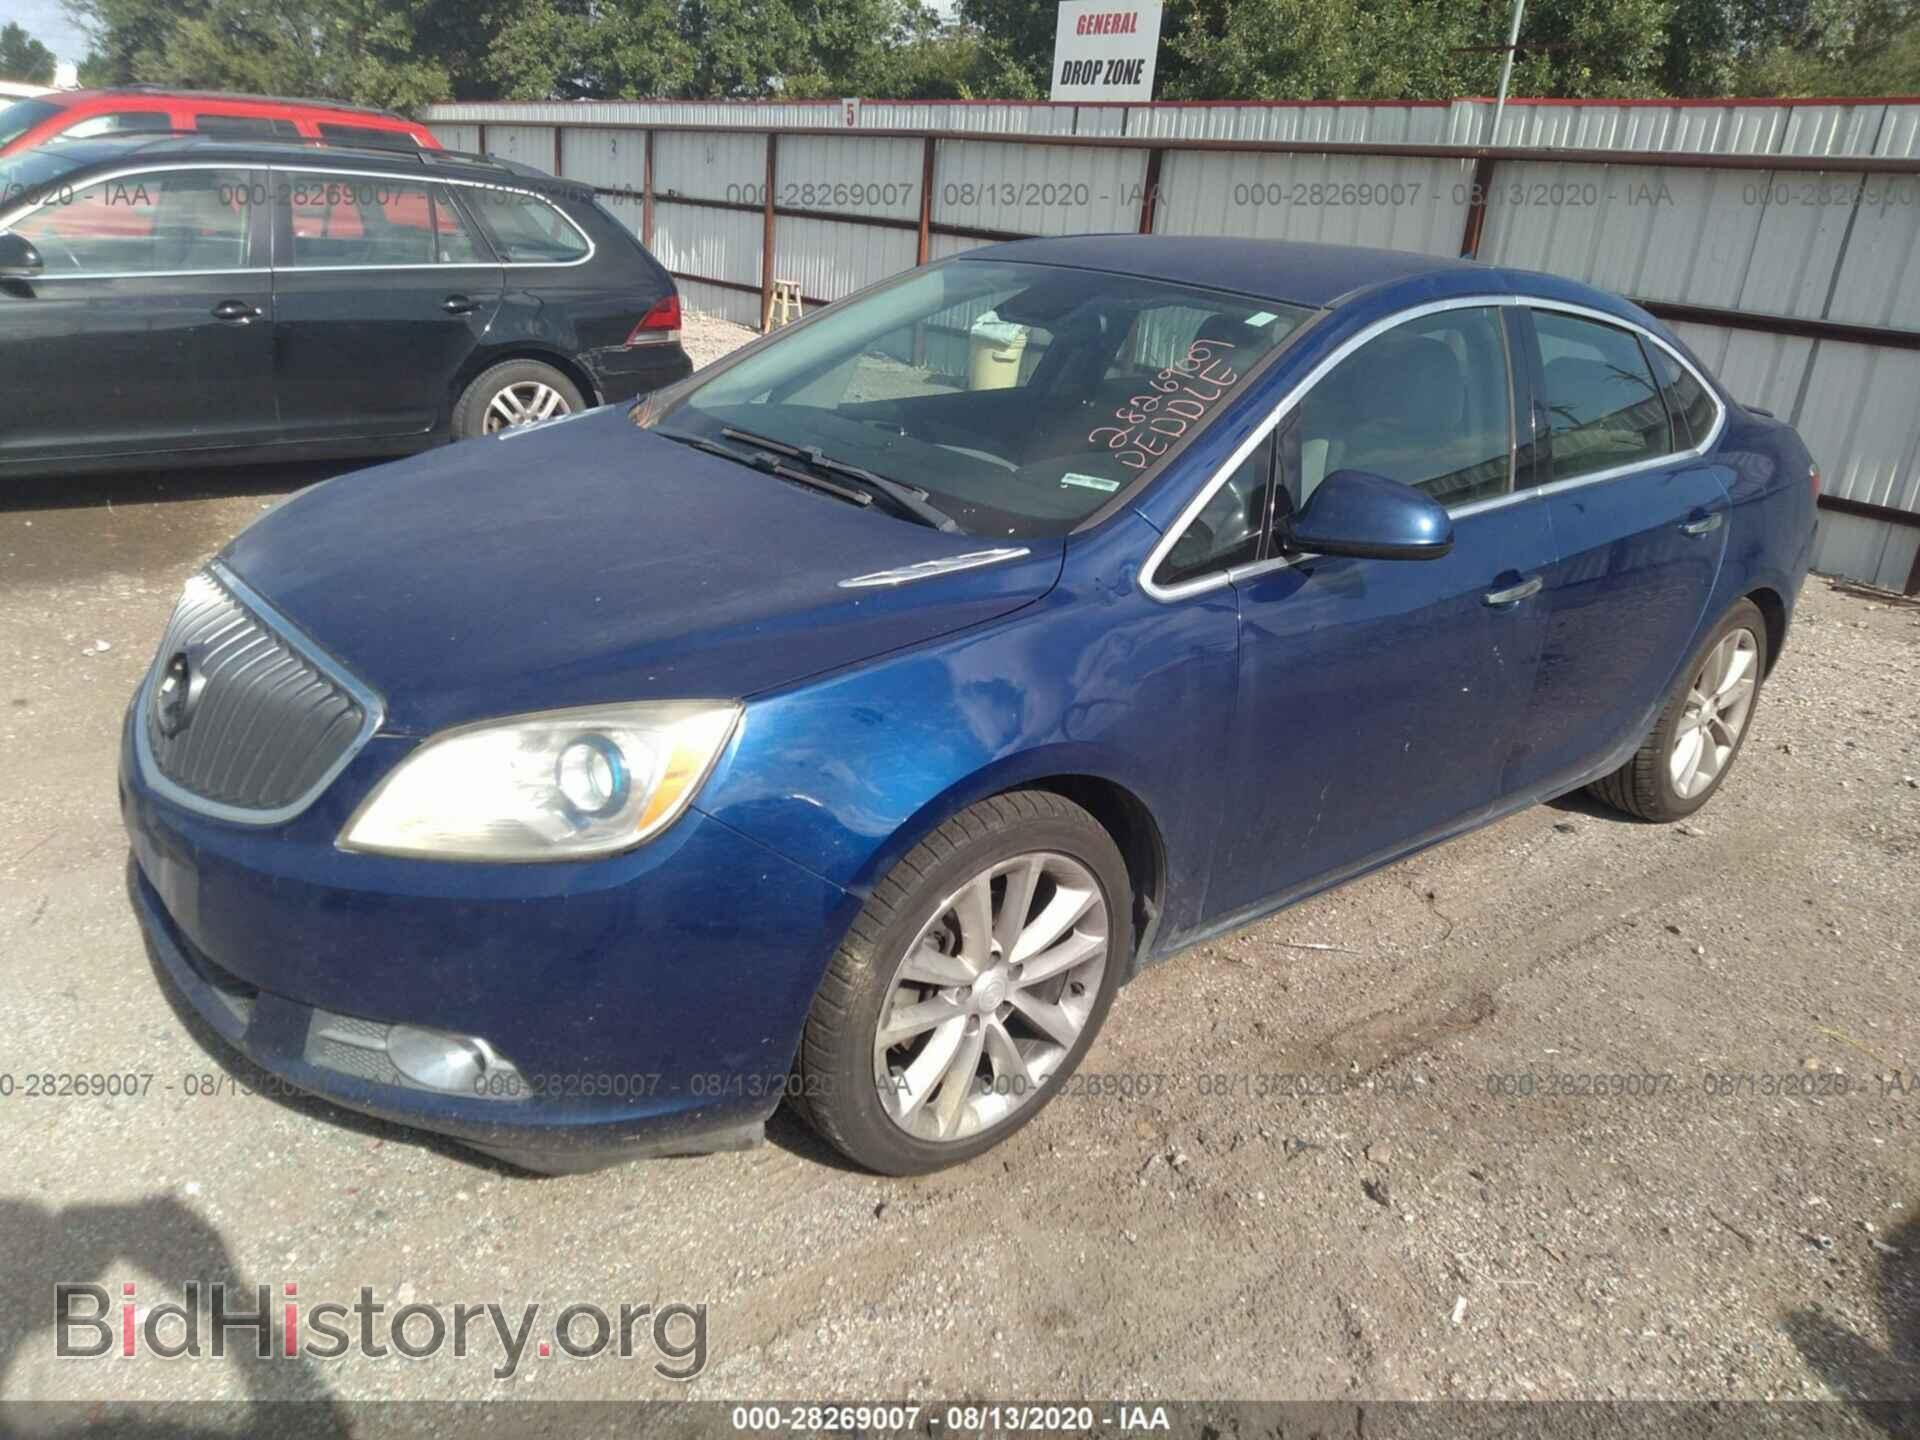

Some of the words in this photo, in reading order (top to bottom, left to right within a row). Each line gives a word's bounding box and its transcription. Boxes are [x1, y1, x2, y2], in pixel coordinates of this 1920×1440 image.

[1076, 12, 1137, 36] GENERAL
[1060, 60, 1103, 85] DROP
[1102, 59, 1145, 85] ZONE
[847, 103, 855, 127] 5
